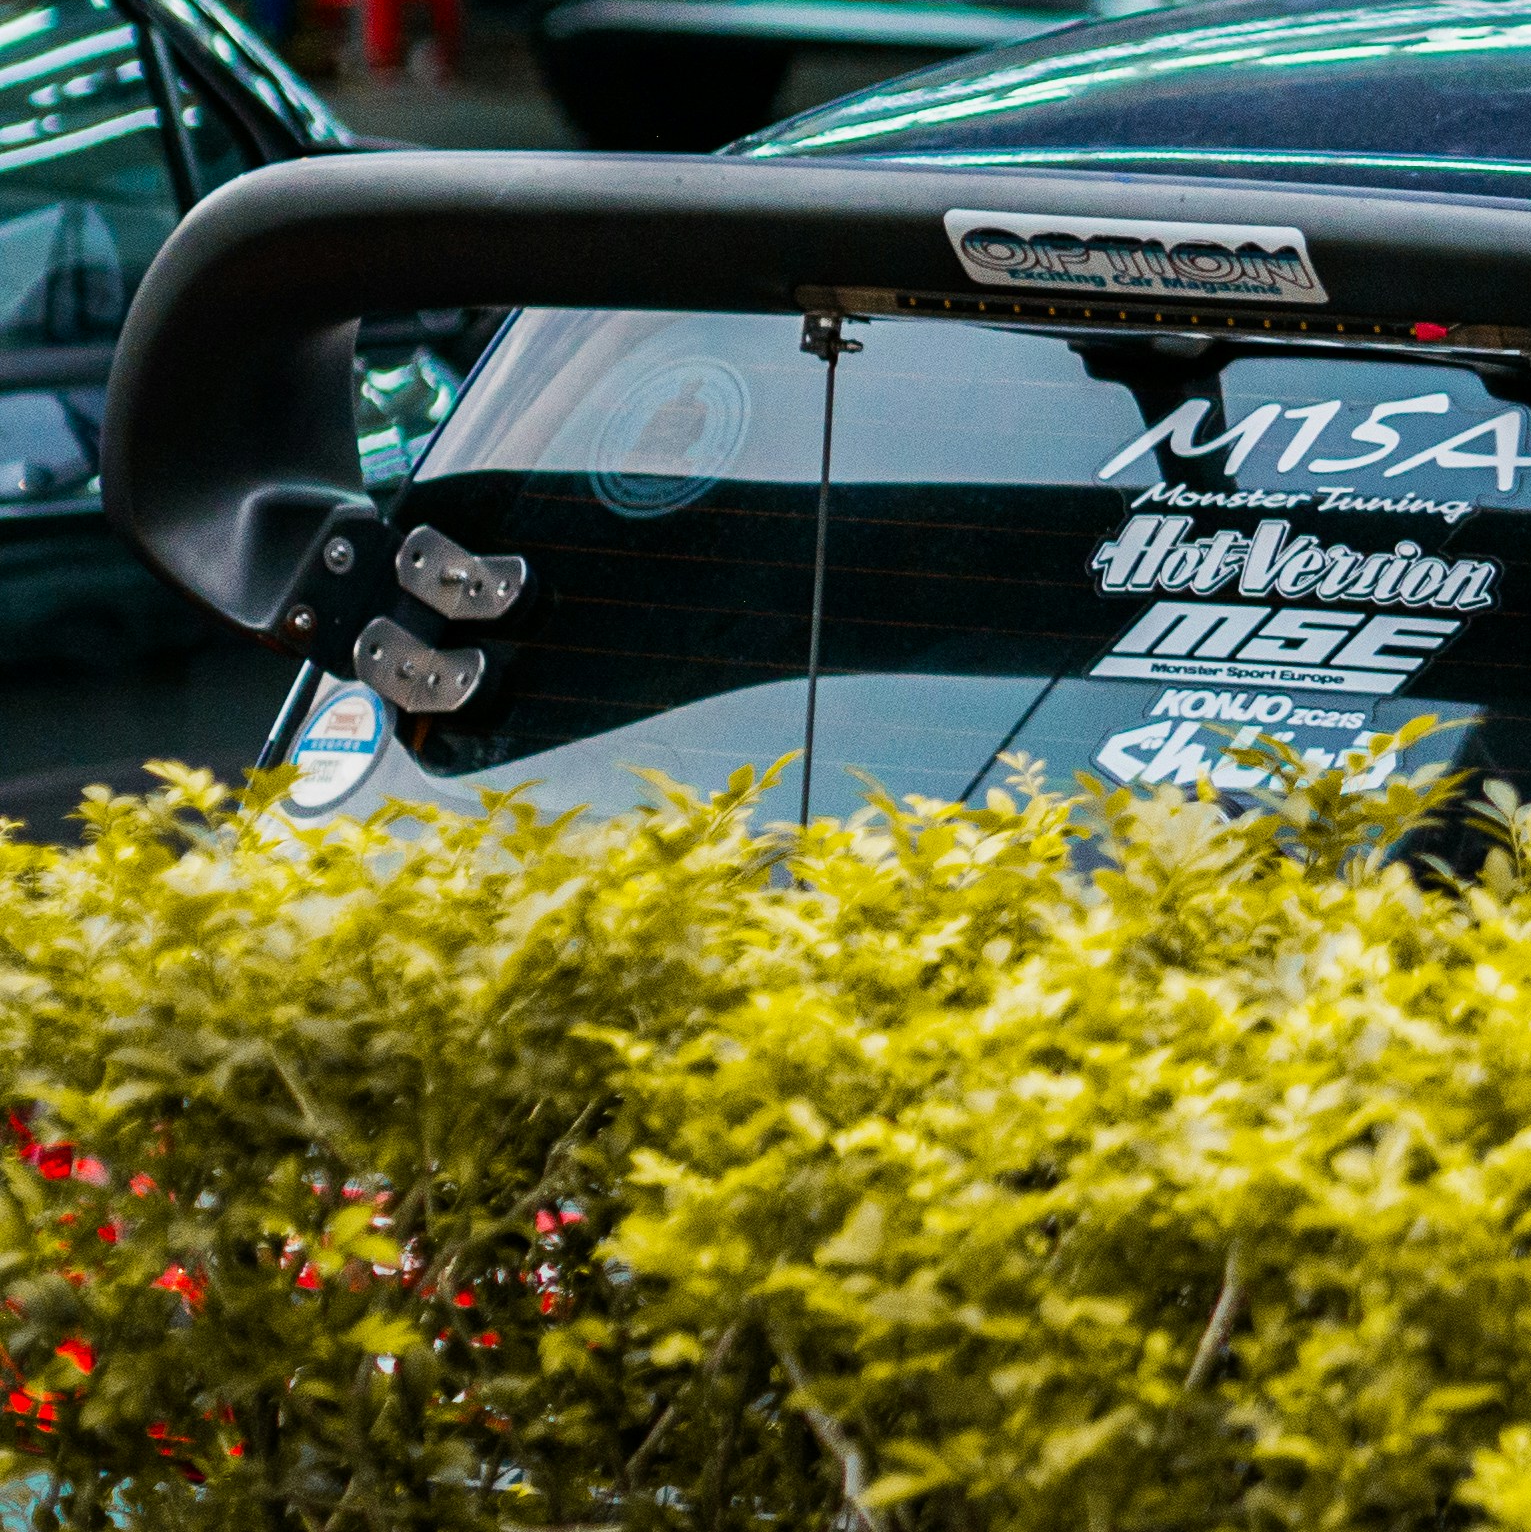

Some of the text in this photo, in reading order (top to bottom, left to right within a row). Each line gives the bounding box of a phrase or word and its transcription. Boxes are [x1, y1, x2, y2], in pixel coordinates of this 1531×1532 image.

[960, 226, 1314, 290] OPTION
[1008, 268, 1282, 296] Exciting Car Magazine
[1131, 482, 1473, 524] Monster Tuning
[1111, 600, 1463, 669] MSE
[1149, 662, 1345, 686] Monster Sport Europe
